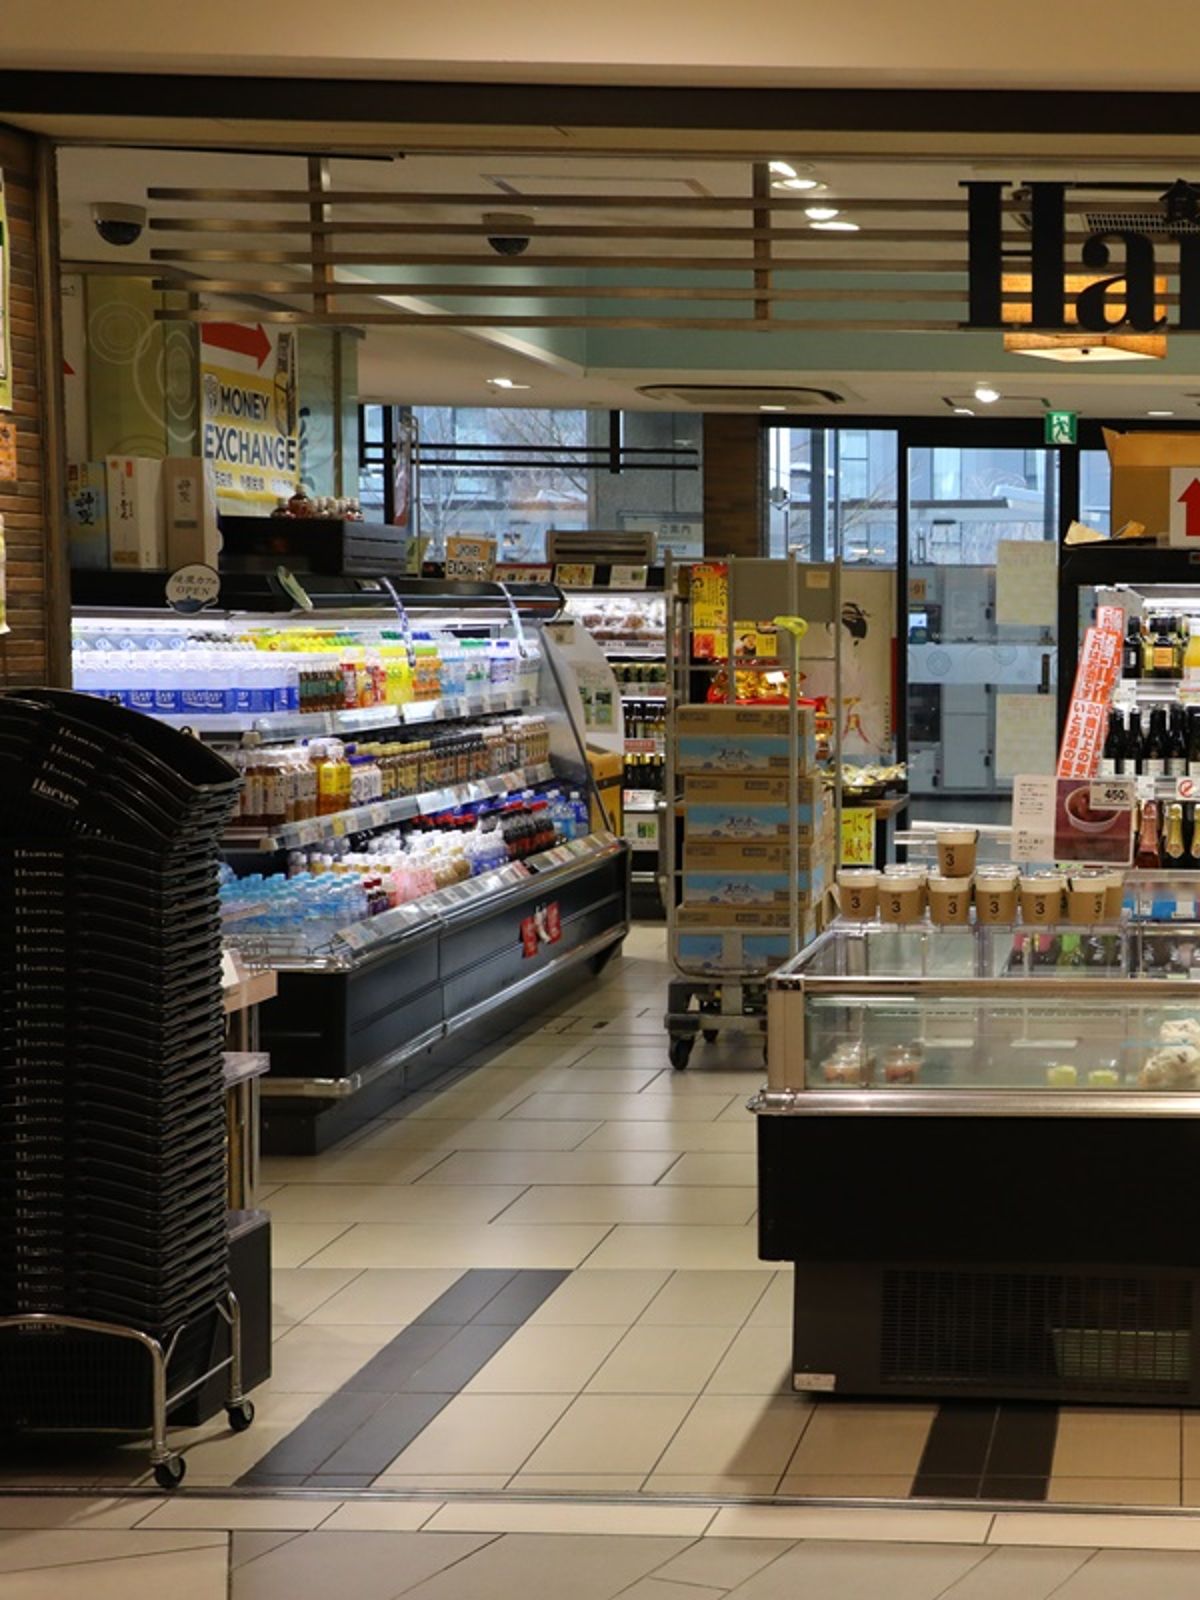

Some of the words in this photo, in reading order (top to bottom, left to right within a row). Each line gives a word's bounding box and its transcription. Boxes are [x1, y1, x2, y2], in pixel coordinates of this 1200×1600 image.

[220, 386, 271, 420] MONEY
[204, 423, 297, 471] EXCHANGE
[176, 585, 211, 596] OPEN
[32, 777, 80, 807] Harves
